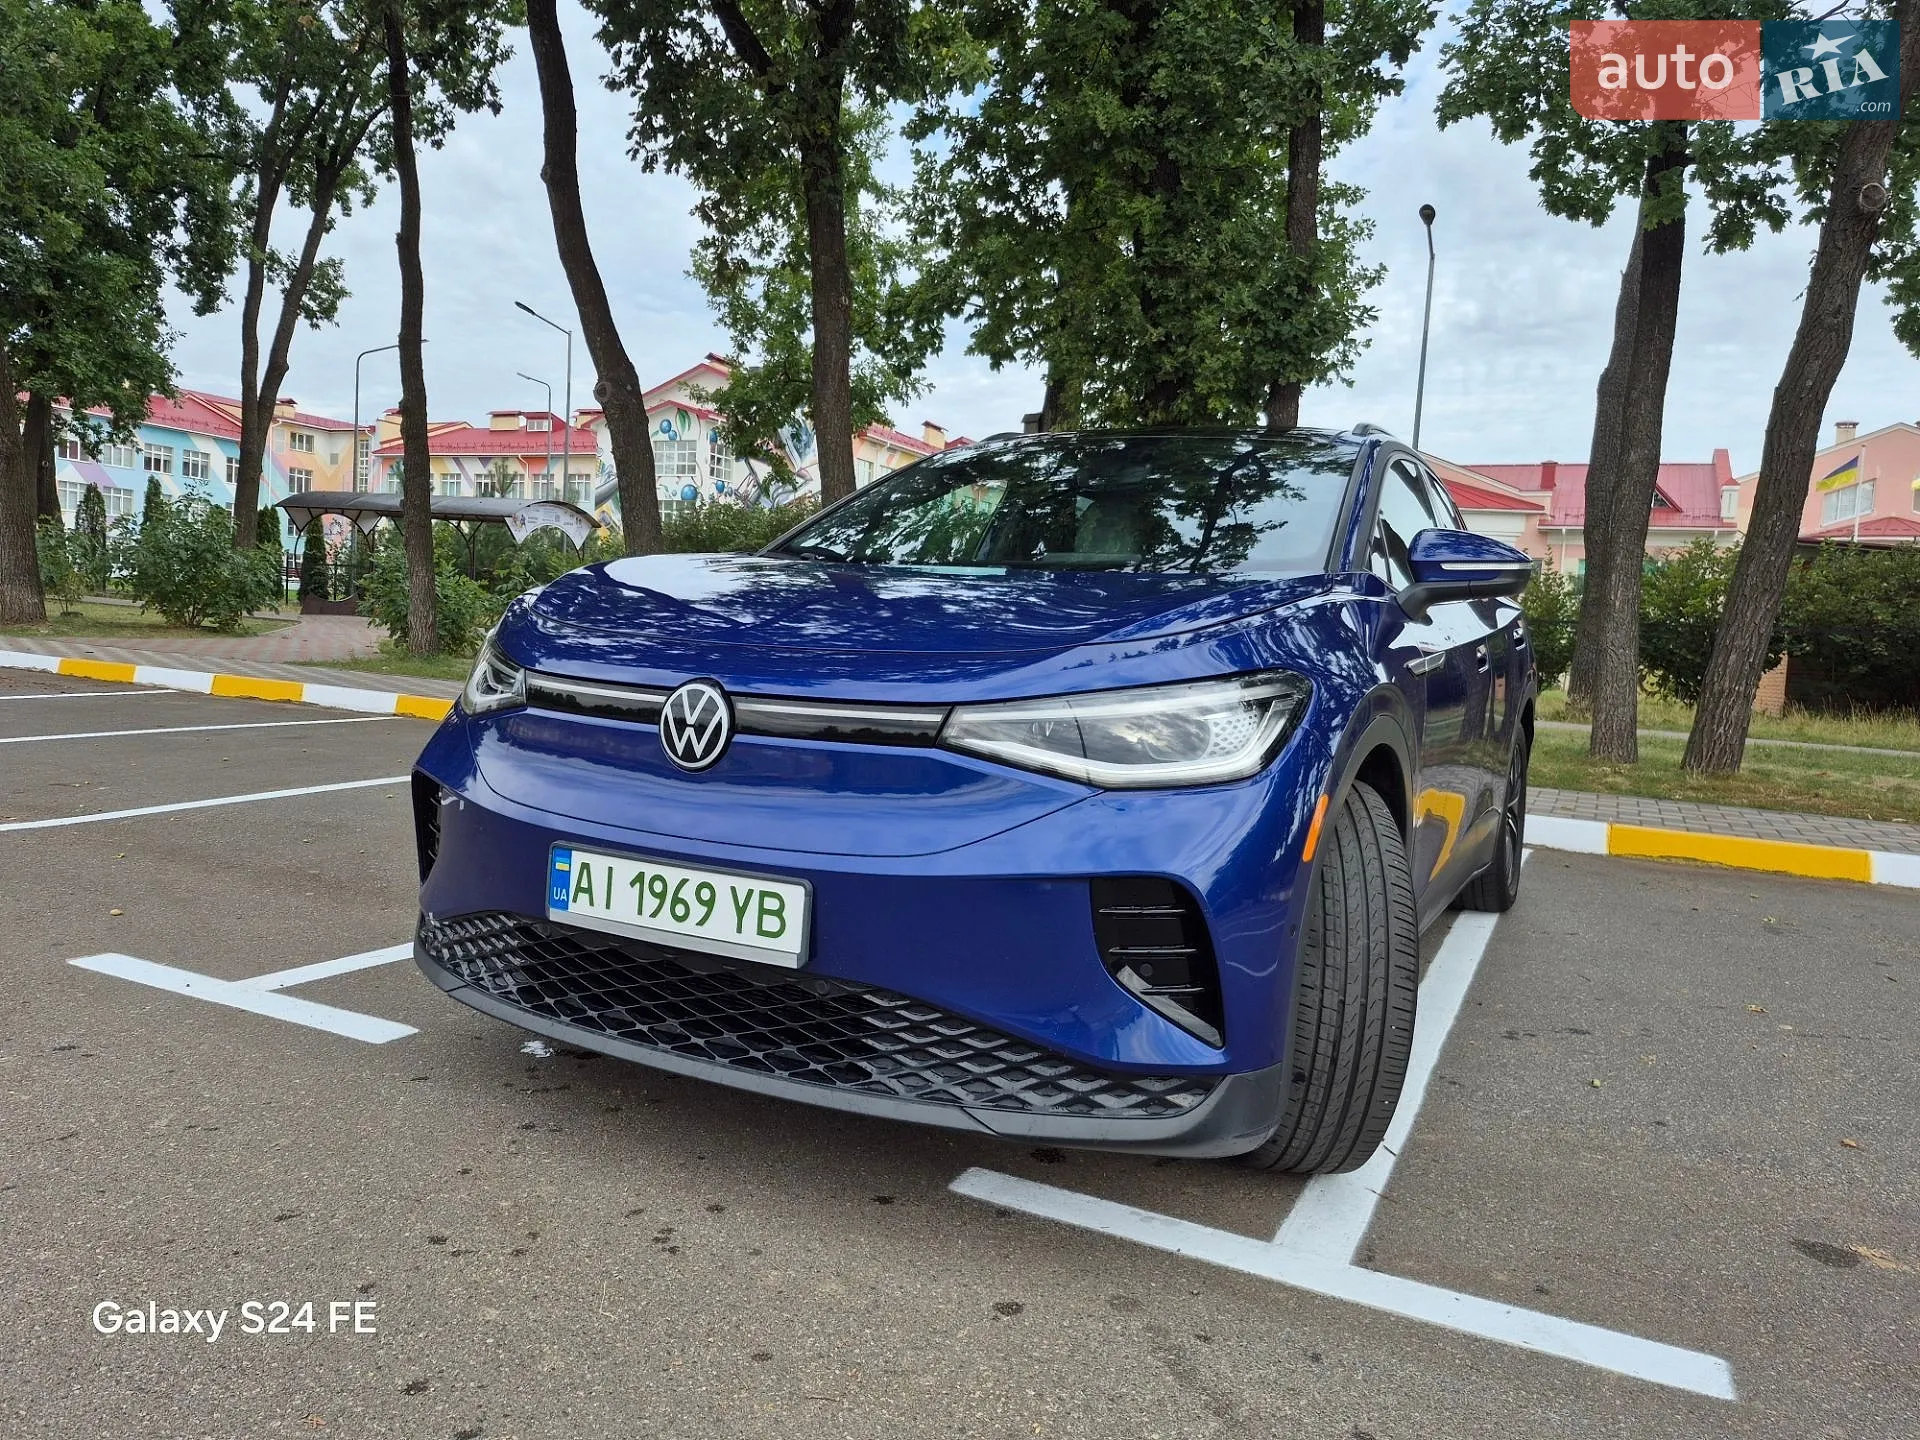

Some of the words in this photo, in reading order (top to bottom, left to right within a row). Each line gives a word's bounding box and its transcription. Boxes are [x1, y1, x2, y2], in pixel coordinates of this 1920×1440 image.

[553, 887, 568, 902] UA
[572, 862, 613, 910] AI
[629, 871, 716, 927] 1969
[730, 885, 786, 939] YB
